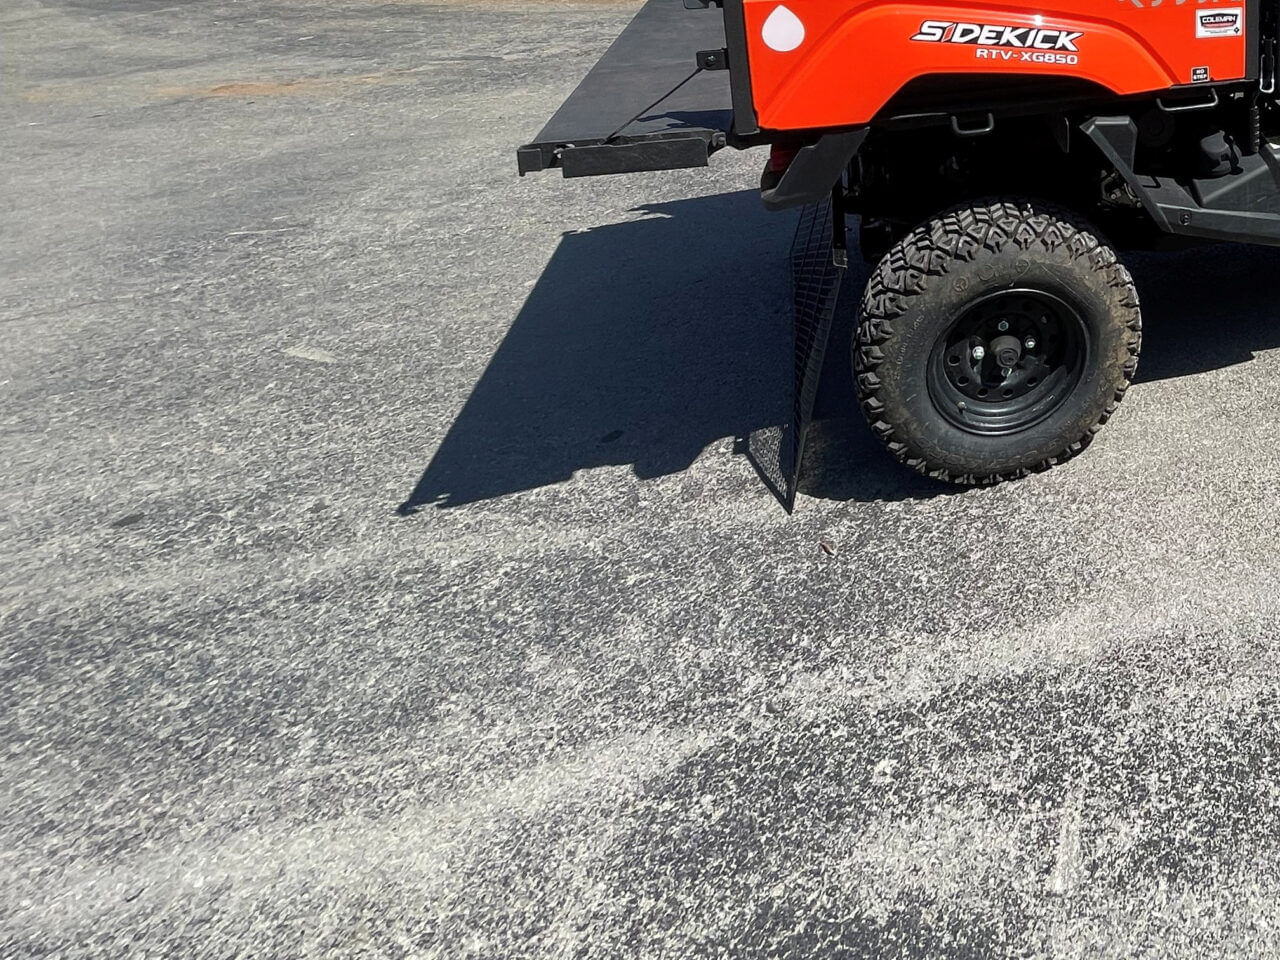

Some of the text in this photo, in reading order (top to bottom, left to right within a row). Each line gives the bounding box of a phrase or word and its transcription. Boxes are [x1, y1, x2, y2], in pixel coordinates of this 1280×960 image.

[1202, 16, 1236, 24] COLEMAN
[911, 20, 1083, 52] SIDEKICK
[976, 49, 1079, 65] RTV-XG850
